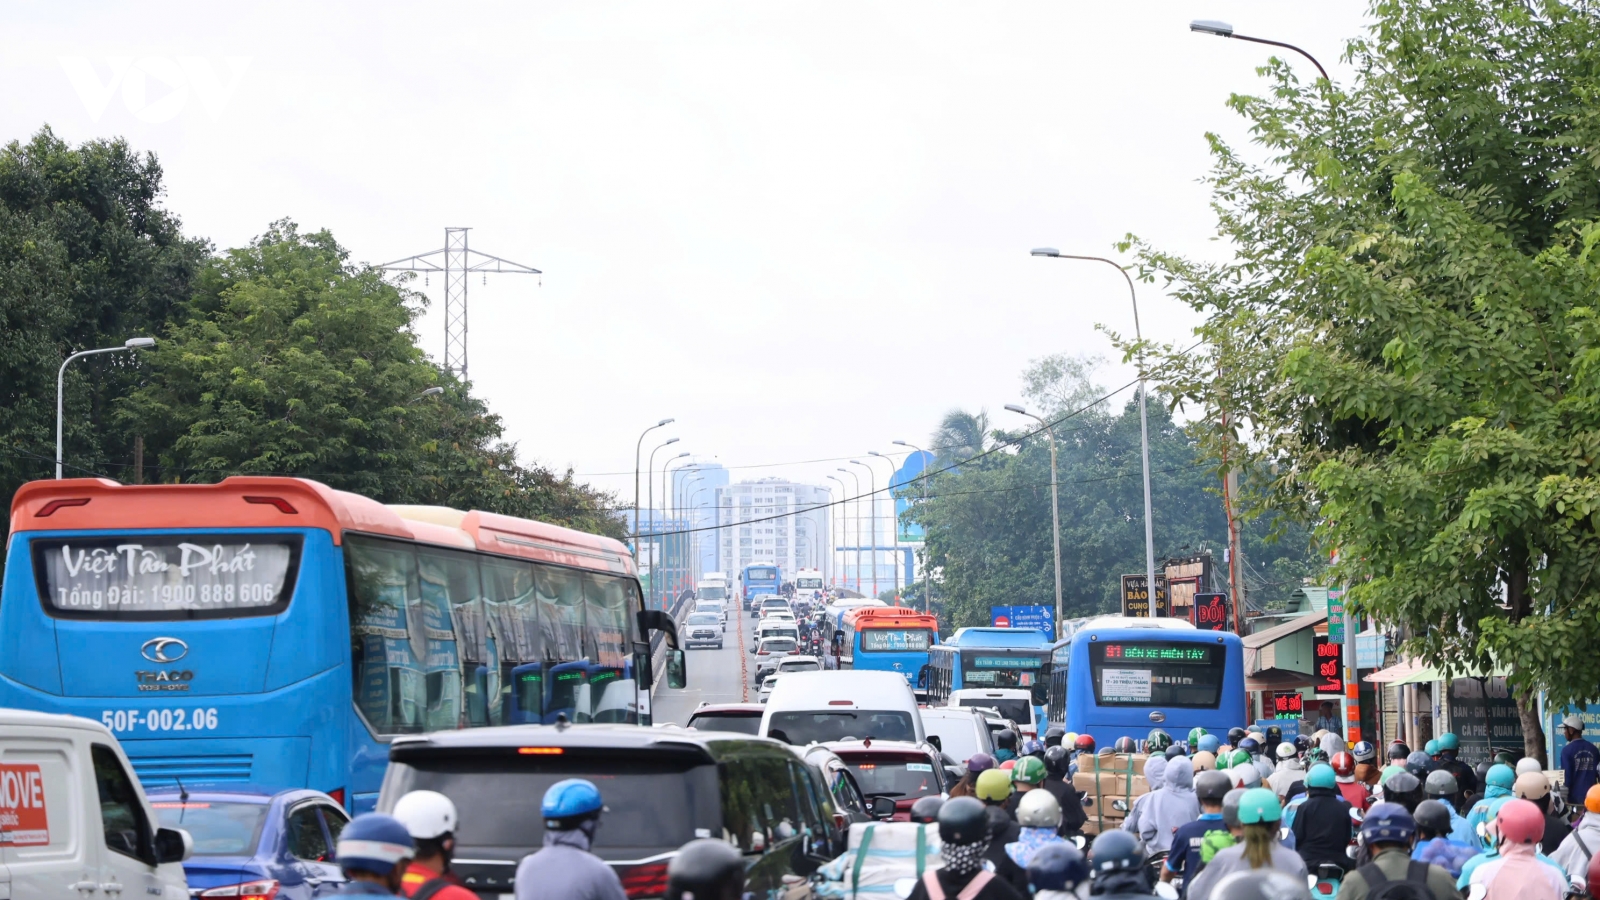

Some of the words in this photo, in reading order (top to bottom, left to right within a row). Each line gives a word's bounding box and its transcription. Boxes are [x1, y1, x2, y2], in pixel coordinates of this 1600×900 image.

[62, 544, 117, 579] Việt
[116, 544, 170, 578] Tân
[177, 543, 257, 577] Phát
[58, 584, 103, 609] Tổng
[107, 586, 145, 605] Đài:
[151, 585, 196, 604] 1900
[200, 584, 235, 603] 888
[239, 583, 274, 602] 606
[1127, 588, 1148, 600] BẢO
[1128, 602, 1148, 610] CUNG
[1198, 596, 1225, 623] ĐỔI
[1125, 646, 1145, 658] BẾN
[1146, 649, 1159, 658] XE
[1186, 648, 1205, 659] TÂY
[1320, 660, 1337, 675] SỐ
[135, 670, 194, 683] THACO
[102, 708, 219, 732] 50F-002.06
